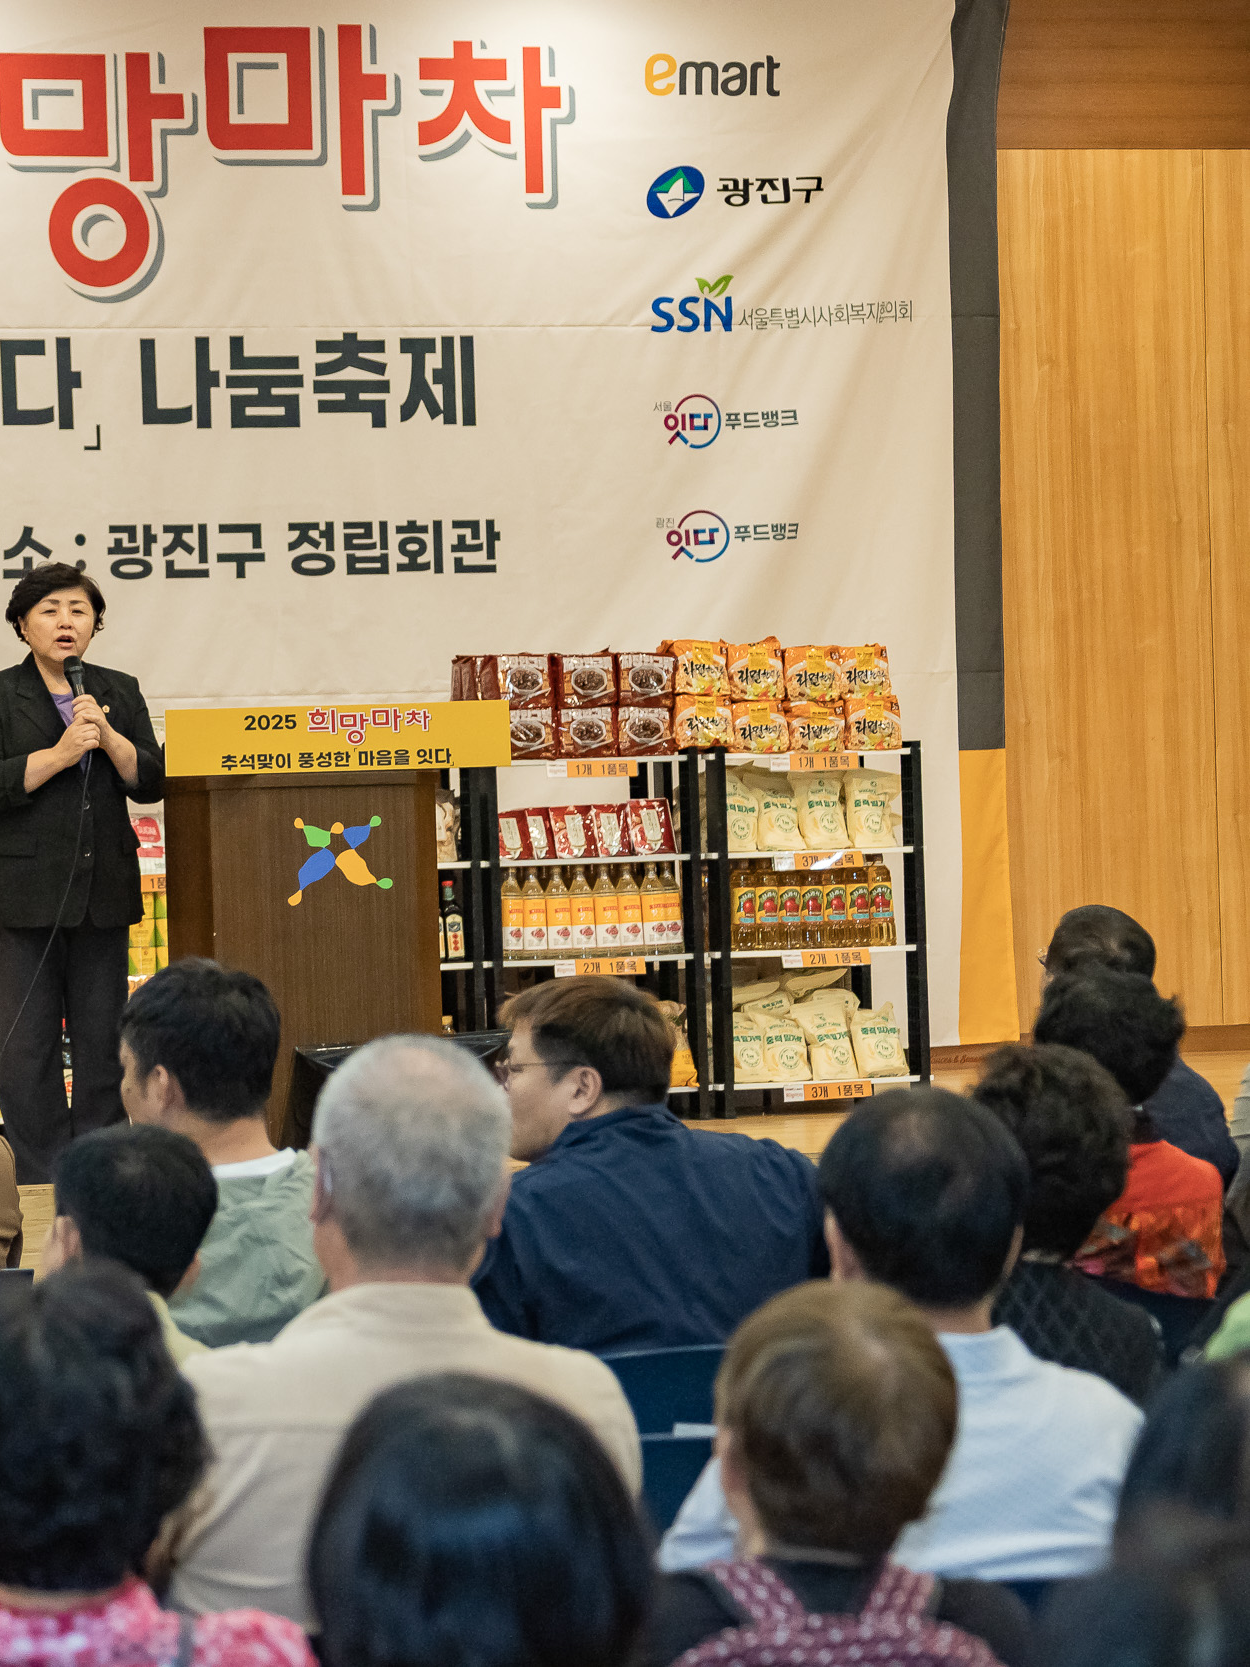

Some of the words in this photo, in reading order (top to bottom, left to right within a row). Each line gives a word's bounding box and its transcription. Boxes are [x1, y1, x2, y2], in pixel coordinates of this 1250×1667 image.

[644, 53, 781, 97] emart
[716, 175, 824, 207] 광진구
[650, 295, 734, 333] SSN
[139, 331, 478, 429] 나눔축제
[725, 409, 799, 430] 푸드뱅크
[734, 522, 800, 542] 푸드뱅크
[105, 522, 267, 581] 광진구
[286, 518, 501, 576] 정립회관
[243, 713, 297, 731] 2025
[306, 707, 432, 746] 희망마차
[220, 752, 292, 771] 추석맞이
[298, 751, 351, 769] 풍성한
[575, 764, 592, 776] 1개
[601, 763, 628, 776] 1품목
[798, 756, 815, 769] 1개
[822, 755, 850, 768] 1품목
[583, 961, 601, 974] 2개
[609, 960, 637, 973] 1품목
[809, 953, 827, 965] 2개
[835, 951, 863, 964] 1품목
[811, 1085, 829, 1099] 3개
[837, 1083, 864, 1097] 1품목
